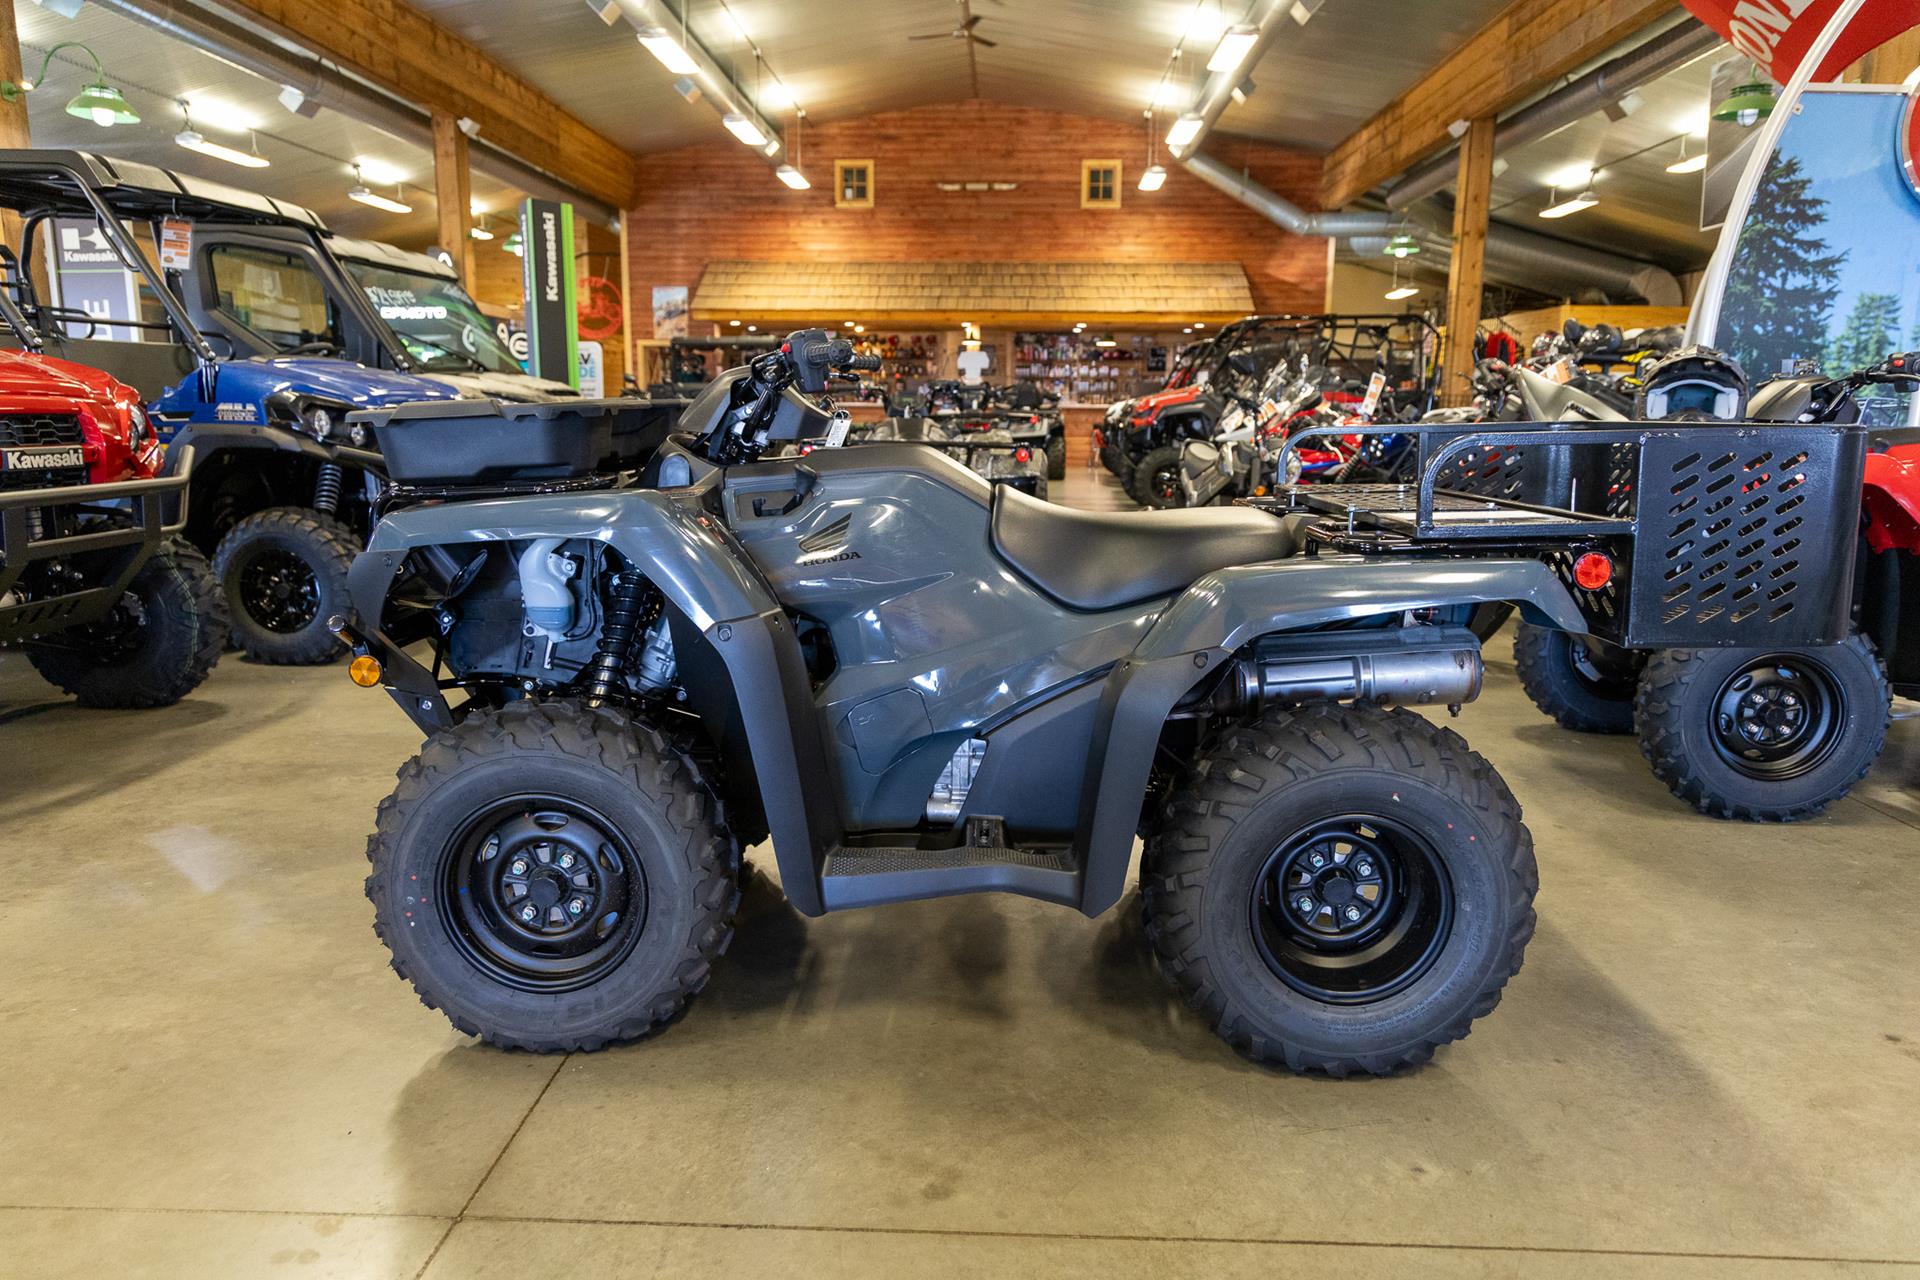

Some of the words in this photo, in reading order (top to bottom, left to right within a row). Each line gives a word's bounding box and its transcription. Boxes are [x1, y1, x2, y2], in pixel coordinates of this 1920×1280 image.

[63, 250, 119, 262] Kawasaki
[542, 211, 559, 302] Kawasaki
[7, 448, 84, 470] Kawasaki
[803, 551, 863, 567] HONDA
